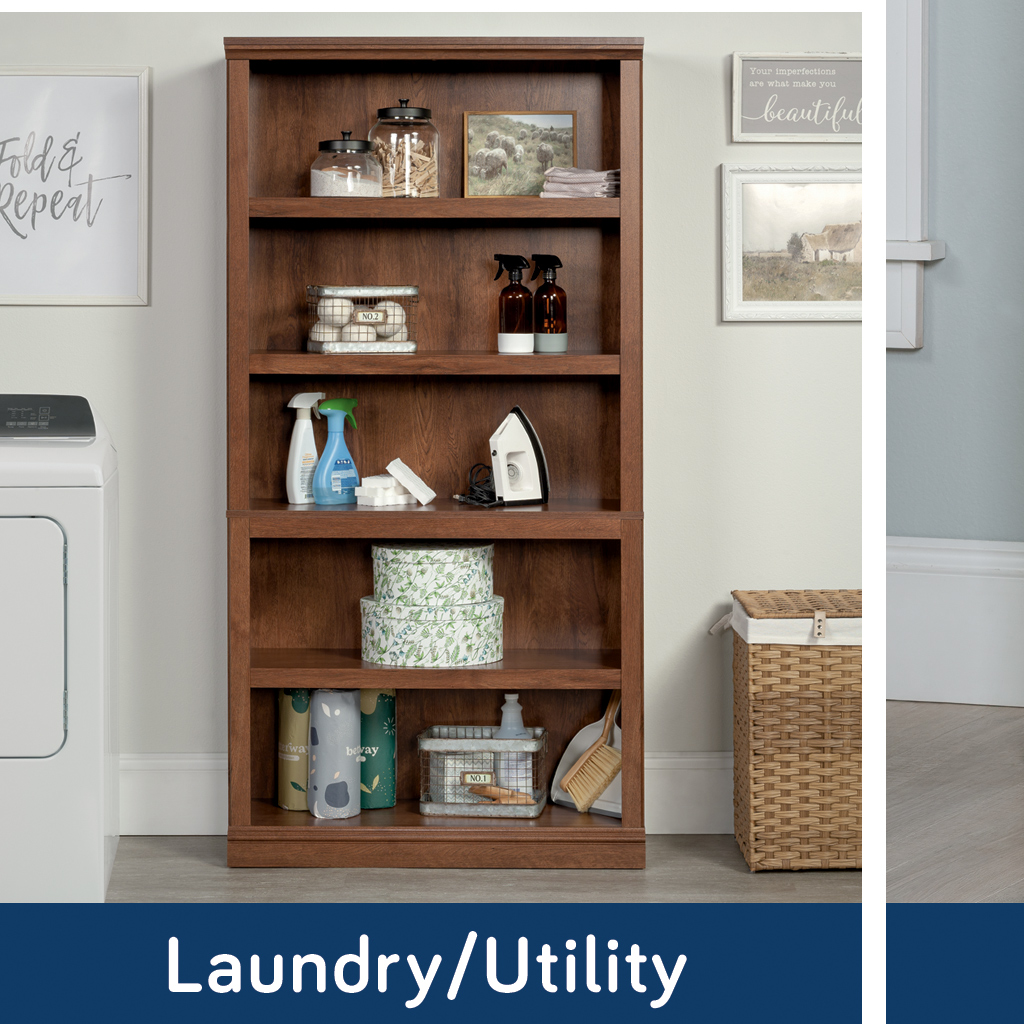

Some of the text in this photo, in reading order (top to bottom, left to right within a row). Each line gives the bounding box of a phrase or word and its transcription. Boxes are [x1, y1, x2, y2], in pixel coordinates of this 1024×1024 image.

[749, 67, 836, 77] Your imperfections
[767, 80, 790, 88] what
[792, 80, 817, 88] make
[818, 81, 837, 89] you
[741, 93, 862, 133] beautiful
[0, 130, 56, 183] Fold
[0, 173, 132, 240] Repeat
[361, 312, 379, 321] NO.2
[470, 774, 487, 782] NO.1
